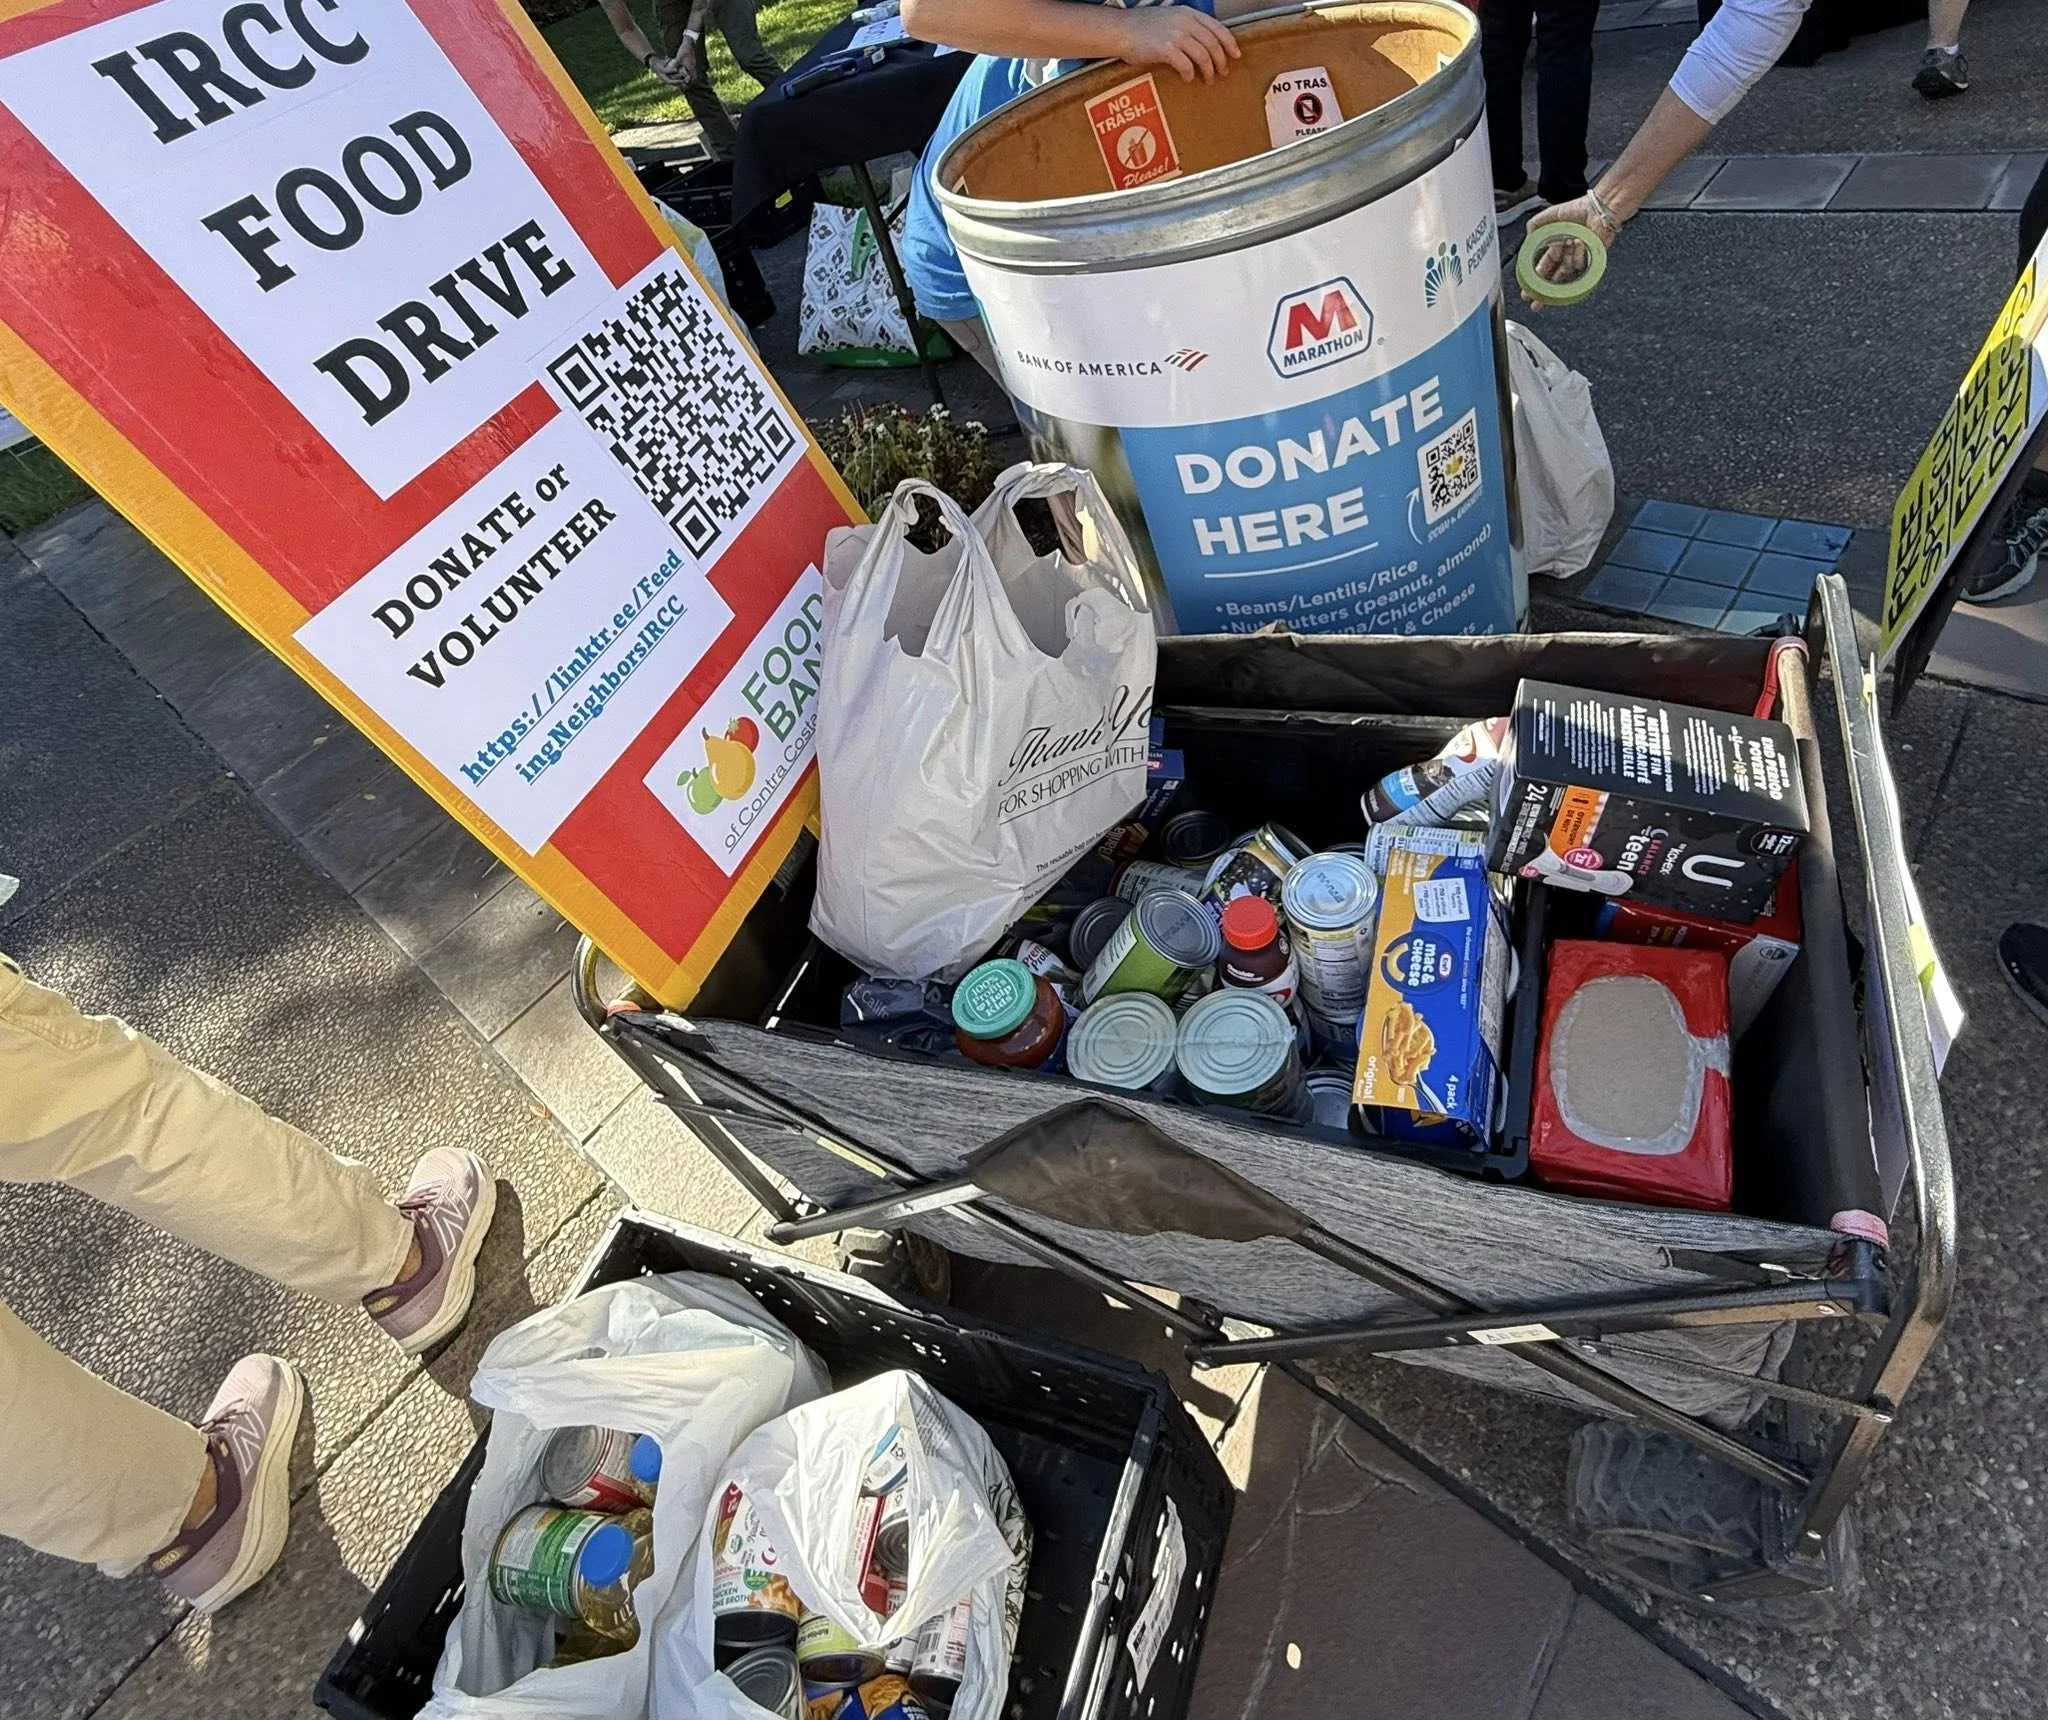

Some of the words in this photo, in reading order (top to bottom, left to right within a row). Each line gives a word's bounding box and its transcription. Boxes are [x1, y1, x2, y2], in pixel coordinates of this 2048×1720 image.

[91, 0, 370, 144] IRCC
[1272, 81, 1291, 94] NO
[1109, 95, 1132, 115] NO
[200, 111, 472, 292] FOOD
[313, 219, 576, 426] DRIVE
[1282, 329, 1364, 368] MARATHON
[1017, 350, 1051, 371] BANK
[1054, 360, 1074, 375] OF
[1078, 360, 1163, 376] AMERICA
[1174, 375, 1444, 496] DONATE
[1953, 349, 1992, 529] FREE
[1192, 488, 1370, 557] HERE
[1920, 410, 1957, 588] SPEECH
[371, 492, 537, 639] DONATE
[535, 463, 571, 503] or
[1283, 604, 1349, 630] utters
[1354, 571, 1434, 616] (peanut,
[1436, 523, 1492, 578] almond)
[1888, 479, 1924, 632] FREE
[406, 497, 616, 689] VOLUNTEER
[1226, 558, 1419, 617] Beans/Lentils/Rice
[1421, 583, 1477, 627] Cheese
[459, 548, 685, 786] https://linktr.ee/Feed
[741, 593, 823, 715] FOOD
[514, 595, 688, 785] ingNeighborsIRCC
[763, 642, 823, 743] BAN
[998, 705, 1106, 787] Thank
[1650, 757, 1661, 775] FIN
[1749, 741, 1767, 790] POVERTY
[1761, 737, 1775, 756] END
[724, 820, 741, 850] of
[738, 765, 787, 827] Contra
[997, 791, 1028, 818] FOR
[1031, 757, 1101, 804] SHOPPING
[1104, 744, 1145, 770] WITH
[1525, 784, 1547, 801] 24
[1765, 759, 1782, 800] PERIOD
[1617, 835, 1645, 872] teen
[1659, 847, 1683, 874] kotex
[1780, 835, 1794, 845] 12
[1423, 890, 1428, 898] no
[1440, 888, 1444, 896] no
[1682, 854, 1745, 887] U
[1363, 1056, 1377, 1098] original
[1446, 1083, 1456, 1109] pack
